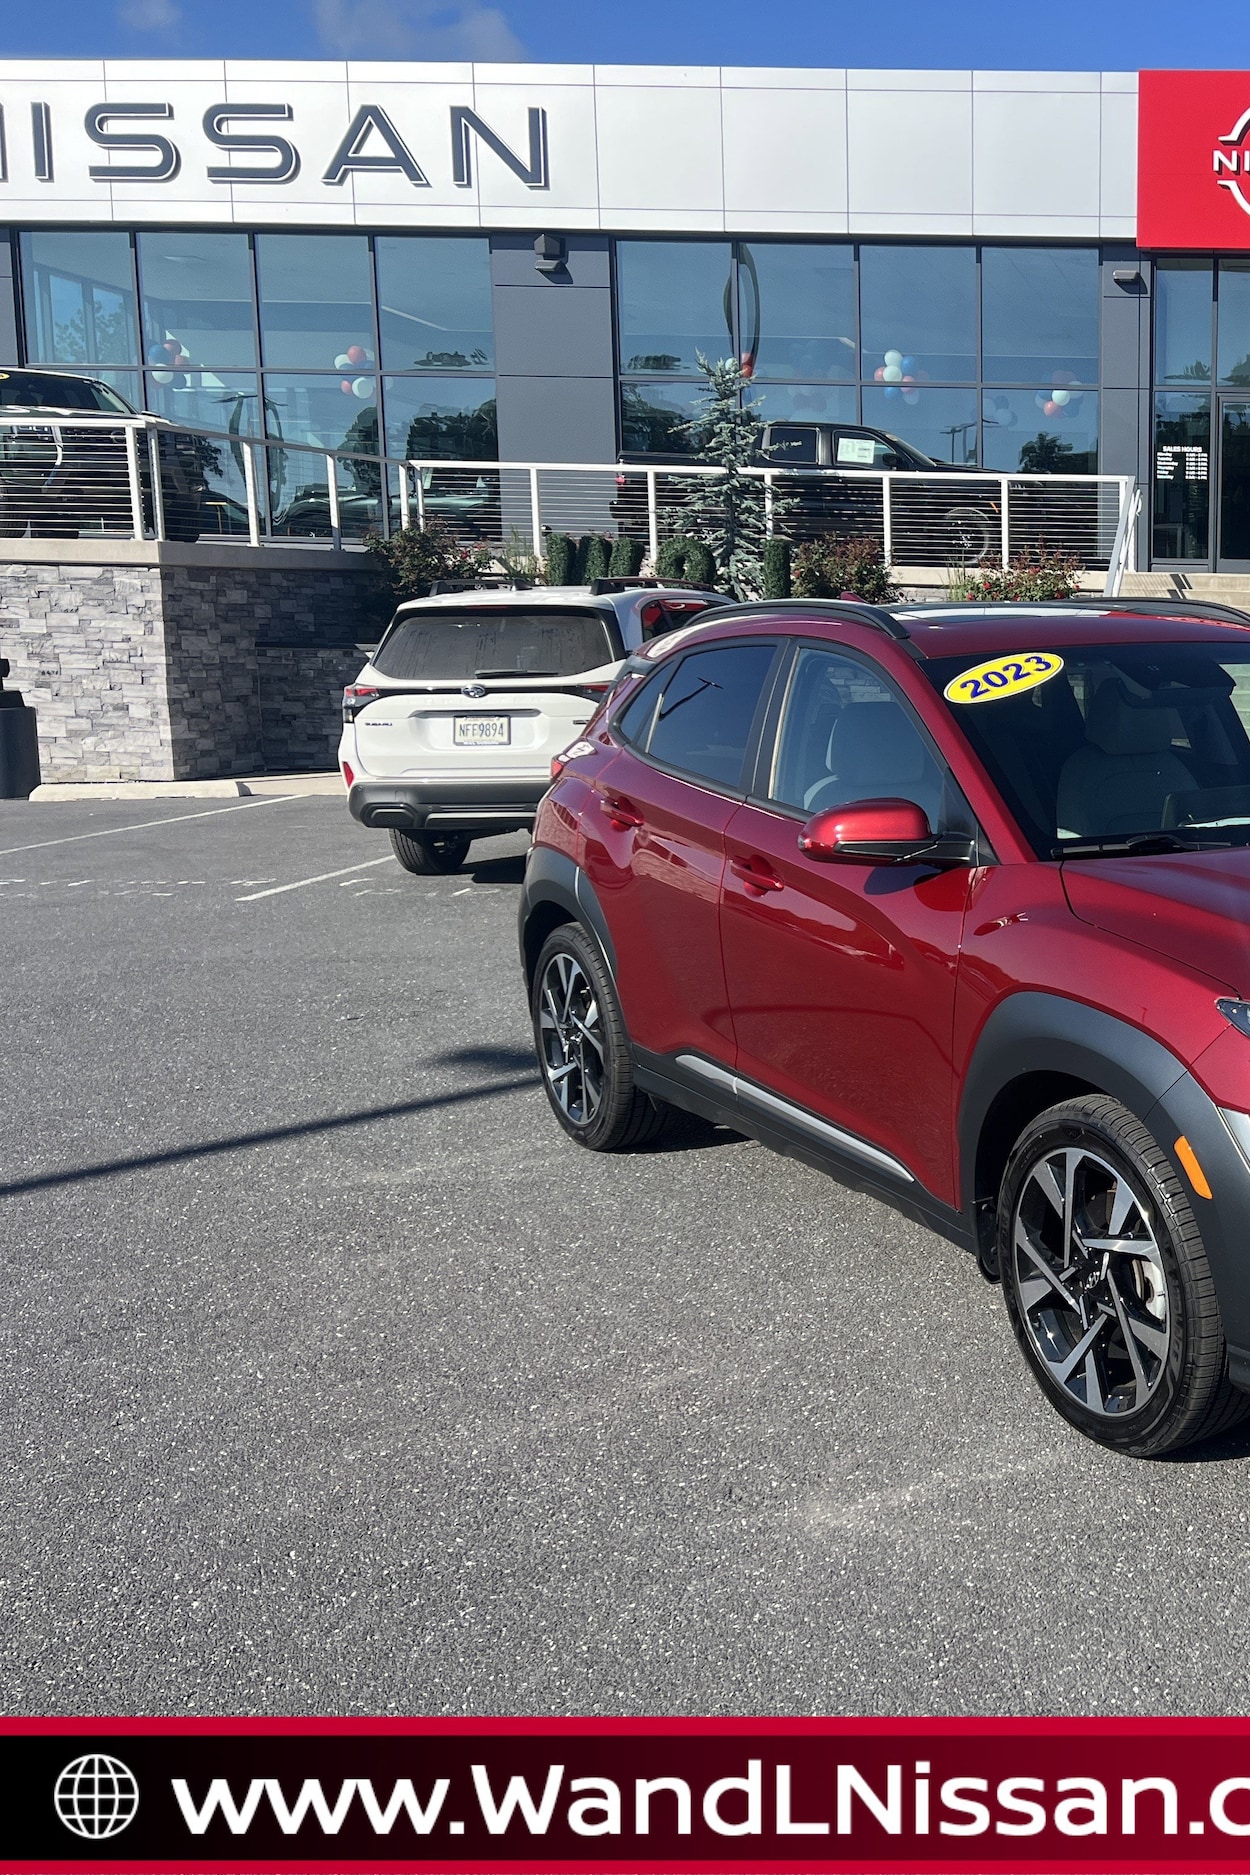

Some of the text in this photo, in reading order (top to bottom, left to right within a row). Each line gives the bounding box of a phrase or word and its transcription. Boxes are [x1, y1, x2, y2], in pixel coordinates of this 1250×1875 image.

[0, 101, 549, 189] ISSAN
[1162, 445, 1181, 453] SALES
[959, 656, 1052, 699] 2023
